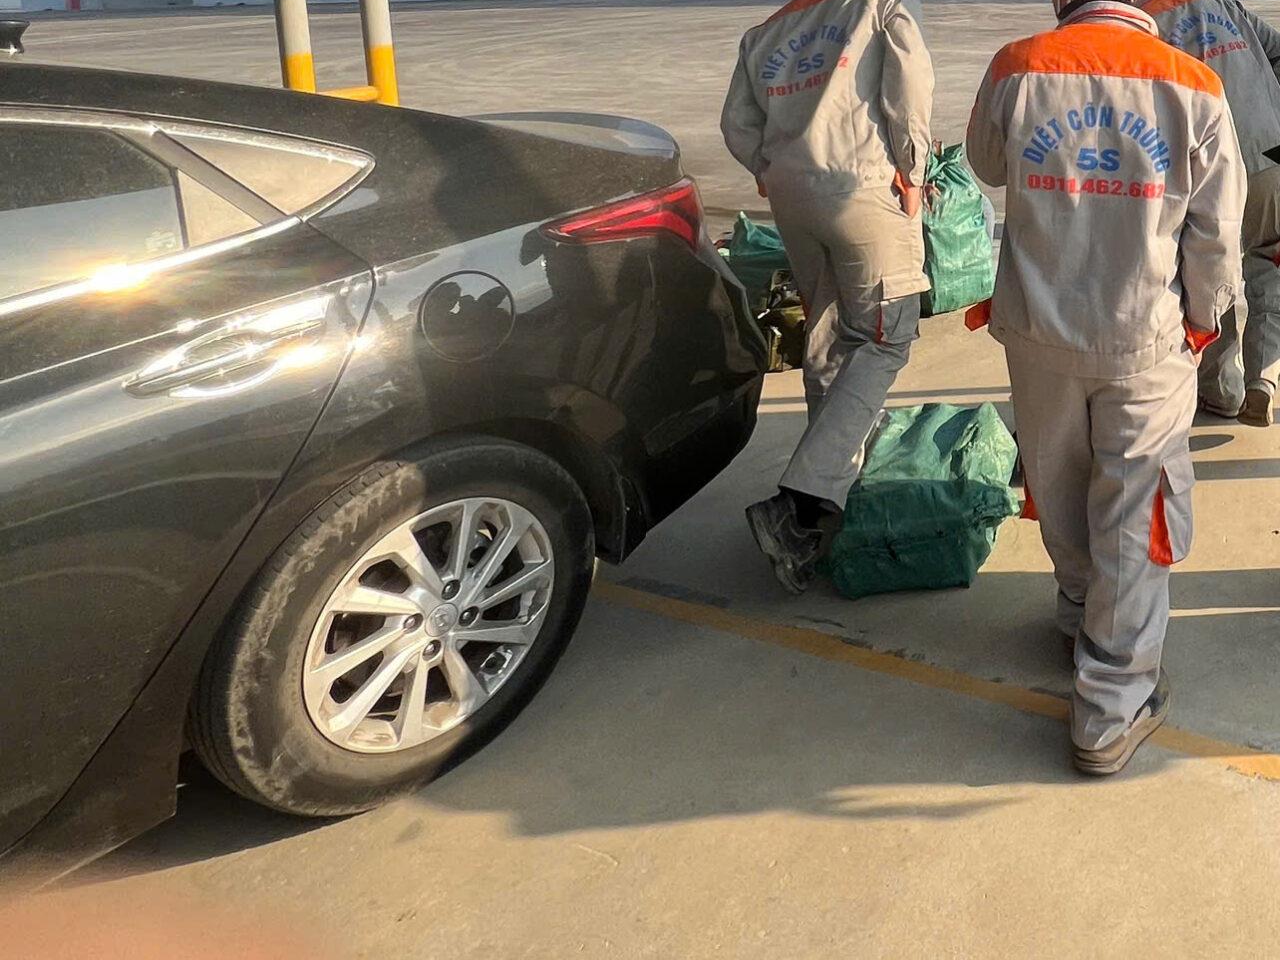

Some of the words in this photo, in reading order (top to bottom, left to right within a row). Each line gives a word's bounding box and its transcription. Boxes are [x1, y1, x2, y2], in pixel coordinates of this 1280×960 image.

[797, 52, 825, 74] 5S
[1022, 117, 1064, 164] DIỆT
[1067, 102, 1114, 131] CÔN
[1120, 111, 1170, 172] TRÙNG
[1076, 147, 1121, 172] 5S
[1028, 174, 1167, 198] 0911.462.682
